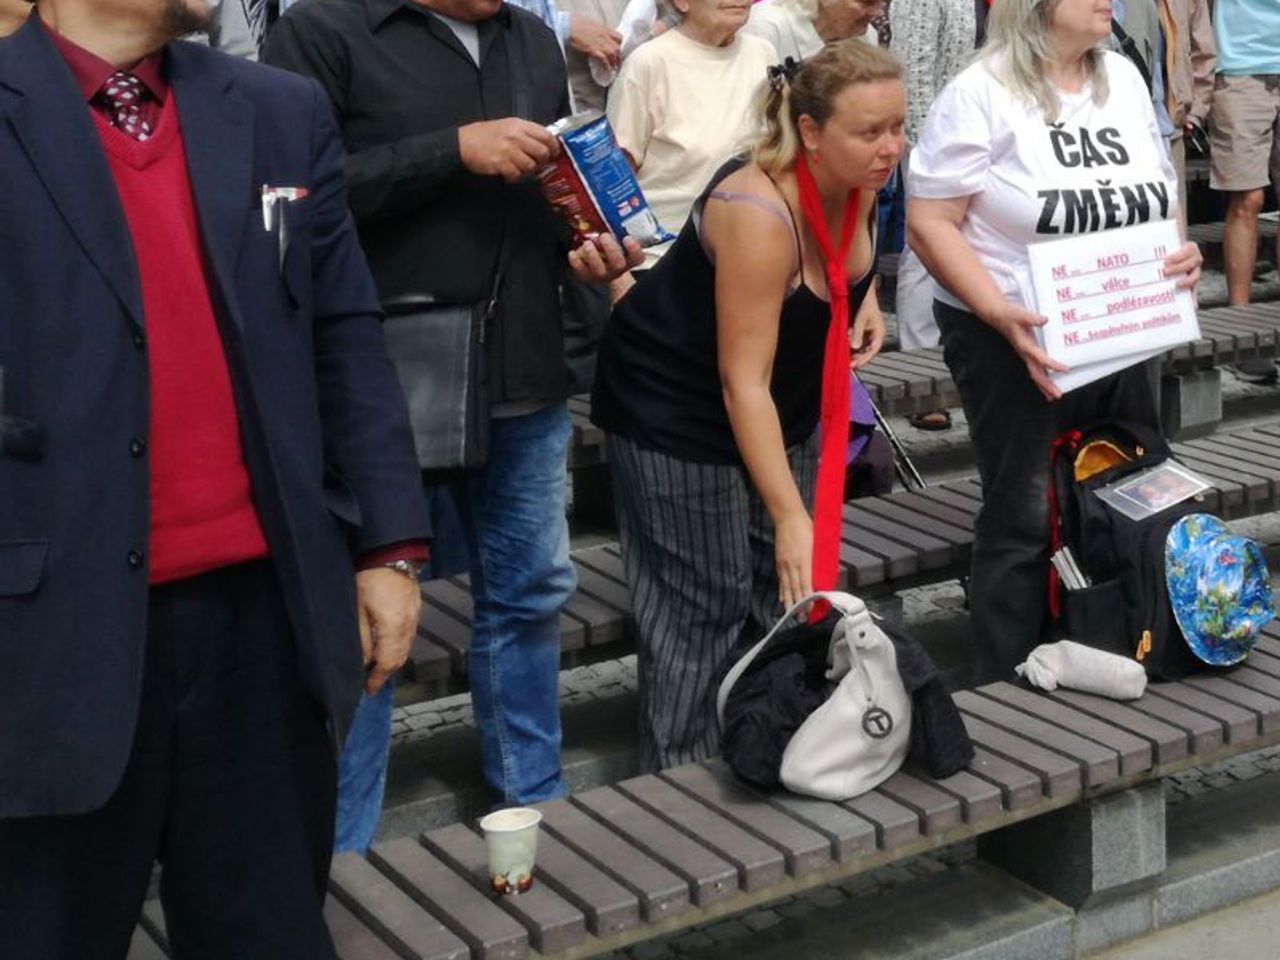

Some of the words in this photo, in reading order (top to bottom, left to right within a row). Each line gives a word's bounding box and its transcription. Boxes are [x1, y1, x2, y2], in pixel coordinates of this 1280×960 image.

[1049, 122, 1130, 169] ČAS
[1036, 179, 1170, 234] ZMĚNY
[1052, 264, 1068, 278] NE
[1097, 253, 1129, 269] NATO
[1056, 286, 1072, 300] NE
[1061, 308, 1077, 322] NE
[1063, 331, 1080, 345] NE
